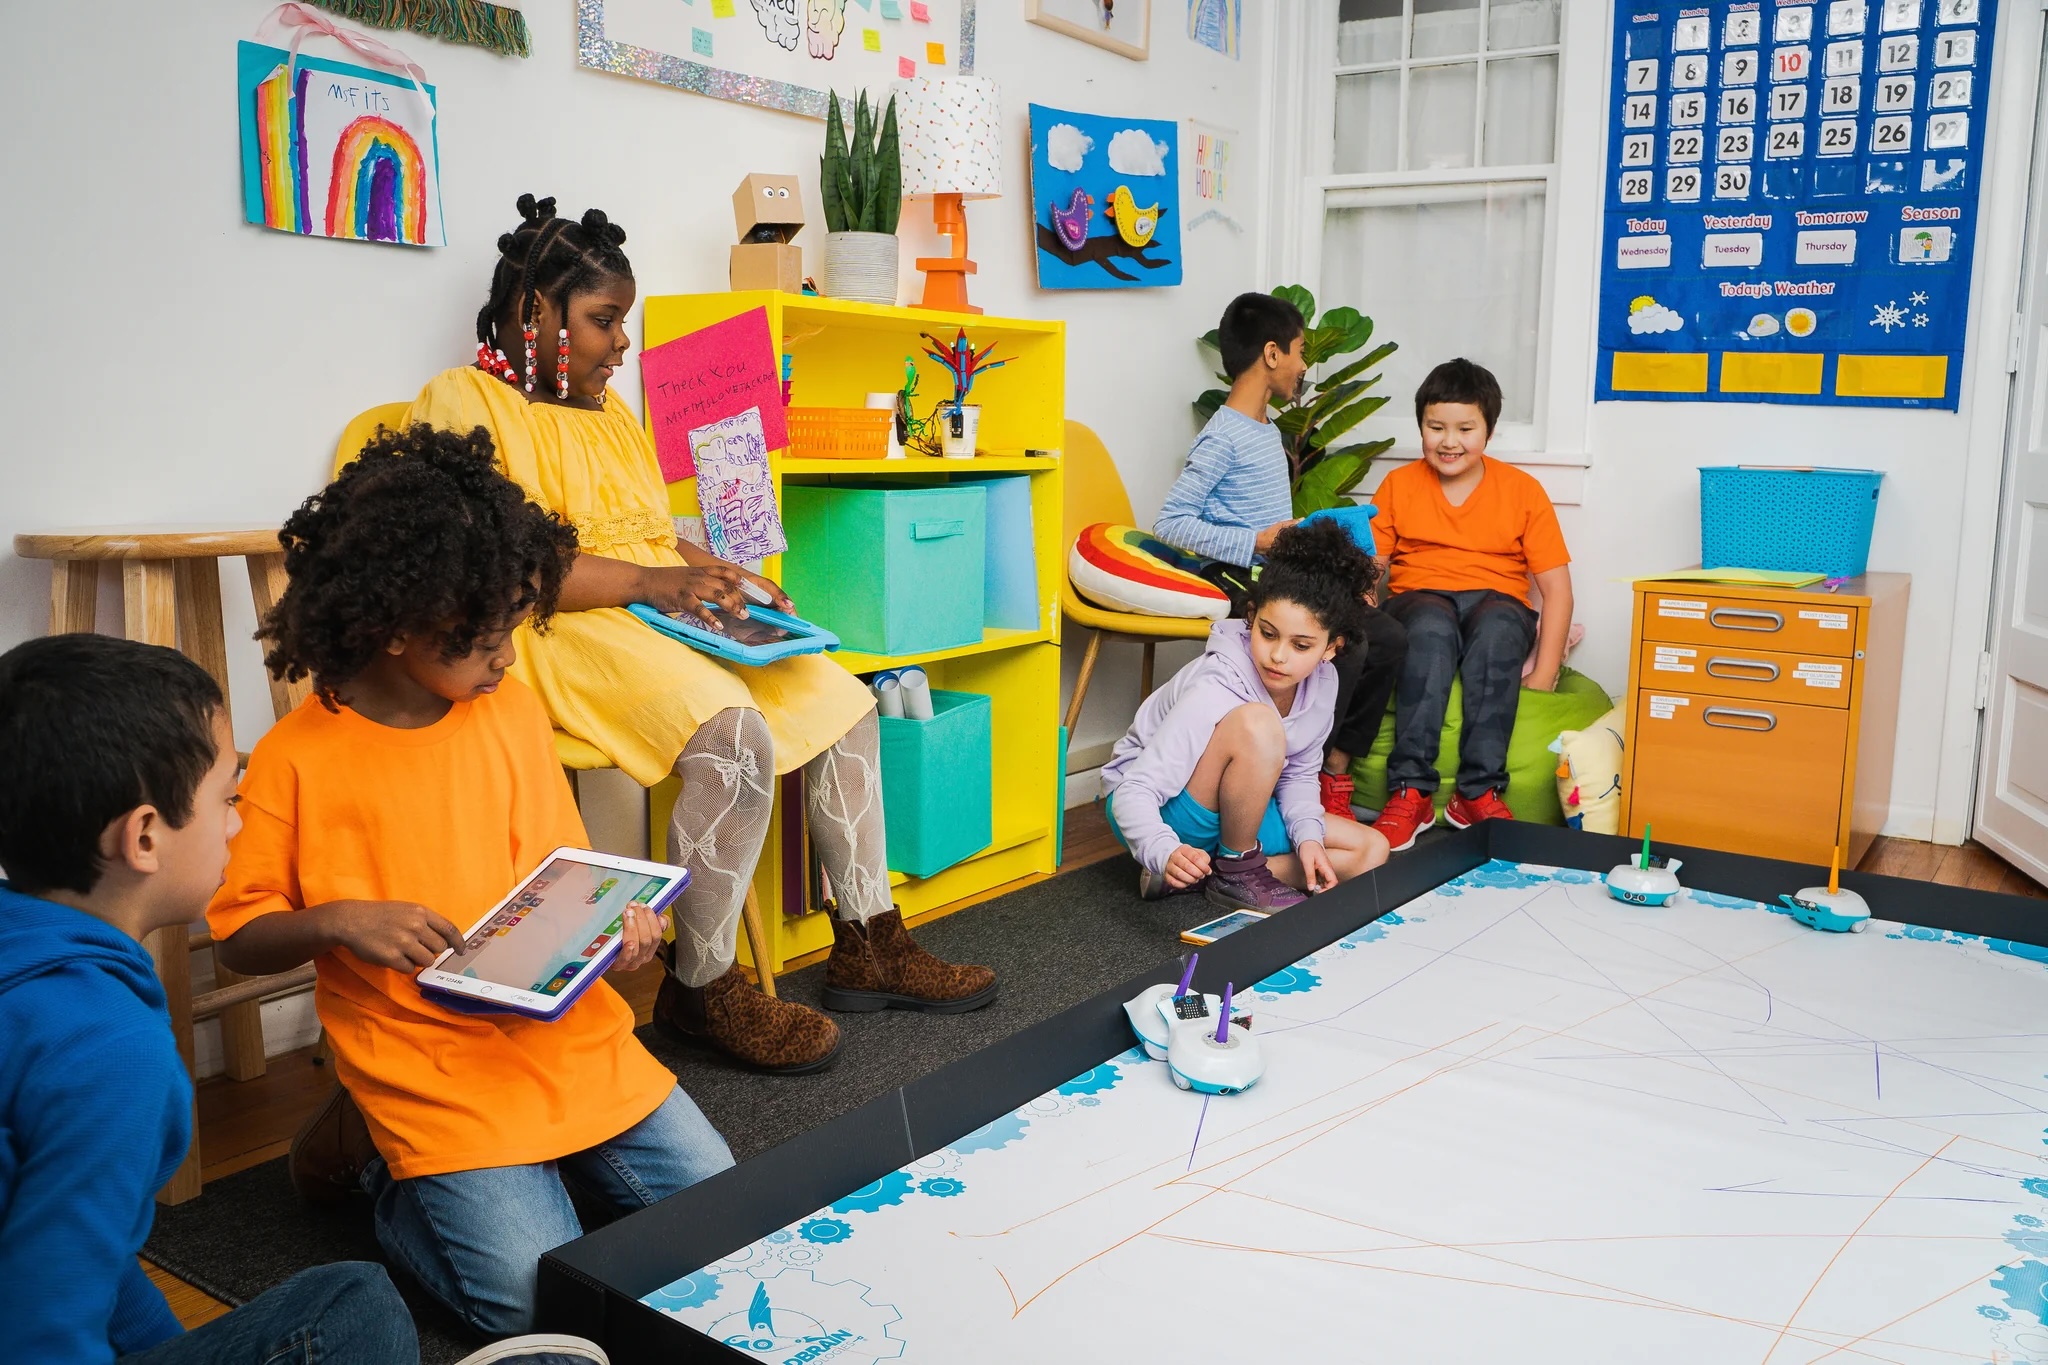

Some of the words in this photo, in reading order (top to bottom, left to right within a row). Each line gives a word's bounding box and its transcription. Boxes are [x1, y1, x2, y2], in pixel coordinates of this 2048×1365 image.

[1680, 8, 1710, 17] Monday
[1729, 3, 1760, 12] Tuesday
[1896, 3, 1910, 22] 5
[1633, 14, 1658, 23] Sunday
[1788, 16, 1800, 33] 3
[1844, 8, 1853, 26] 4
[1691, 25, 1697, 42] 1
[1737, 20, 1749, 38] 2
[1888, 44, 1910, 64] 12
[1944, 39, 1968, 59] 13
[1779, 54, 1801, 72] 10
[1836, 49, 1853, 68] 11
[1638, 68, 1649, 84] 7
[1684, 63, 1696, 80] 8
[1735, 59, 1748, 76] 9
[1831, 86, 1852, 104] 18
[1884, 84, 1907, 103] 19
[1938, 80, 1967, 100] 20
[1680, 100, 1698, 118] 15
[1728, 97, 1748, 115] 16
[1779, 93, 1800, 111] 17
[1632, 103, 1650, 120] 14
[1825, 128, 1851, 146] 25
[1878, 124, 1906, 143] 26
[1934, 120, 1962, 140] 27
[1674, 138, 1698, 155] 22
[1723, 135, 1748, 153] 23
[1773, 132, 1799, 150] 24
[1629, 142, 1648, 158] 21
[1626, 179, 1648, 195] 28
[1672, 175, 1696, 192] 29
[1720, 173, 1746, 190] 30
[1797, 211, 1868, 225] Tomorrow
[1902, 206, 1960, 220] Season
[1627, 218, 1666, 232] Today
[1704, 214, 1772, 230] Yesterday
[1620, 247, 1669, 256] Wednesday
[1714, 246, 1750, 254] Tuesday
[1806, 242, 1848, 251] Thursday
[1720, 282, 1772, 298] Today's
[1775, 280, 1835, 295] Weather
